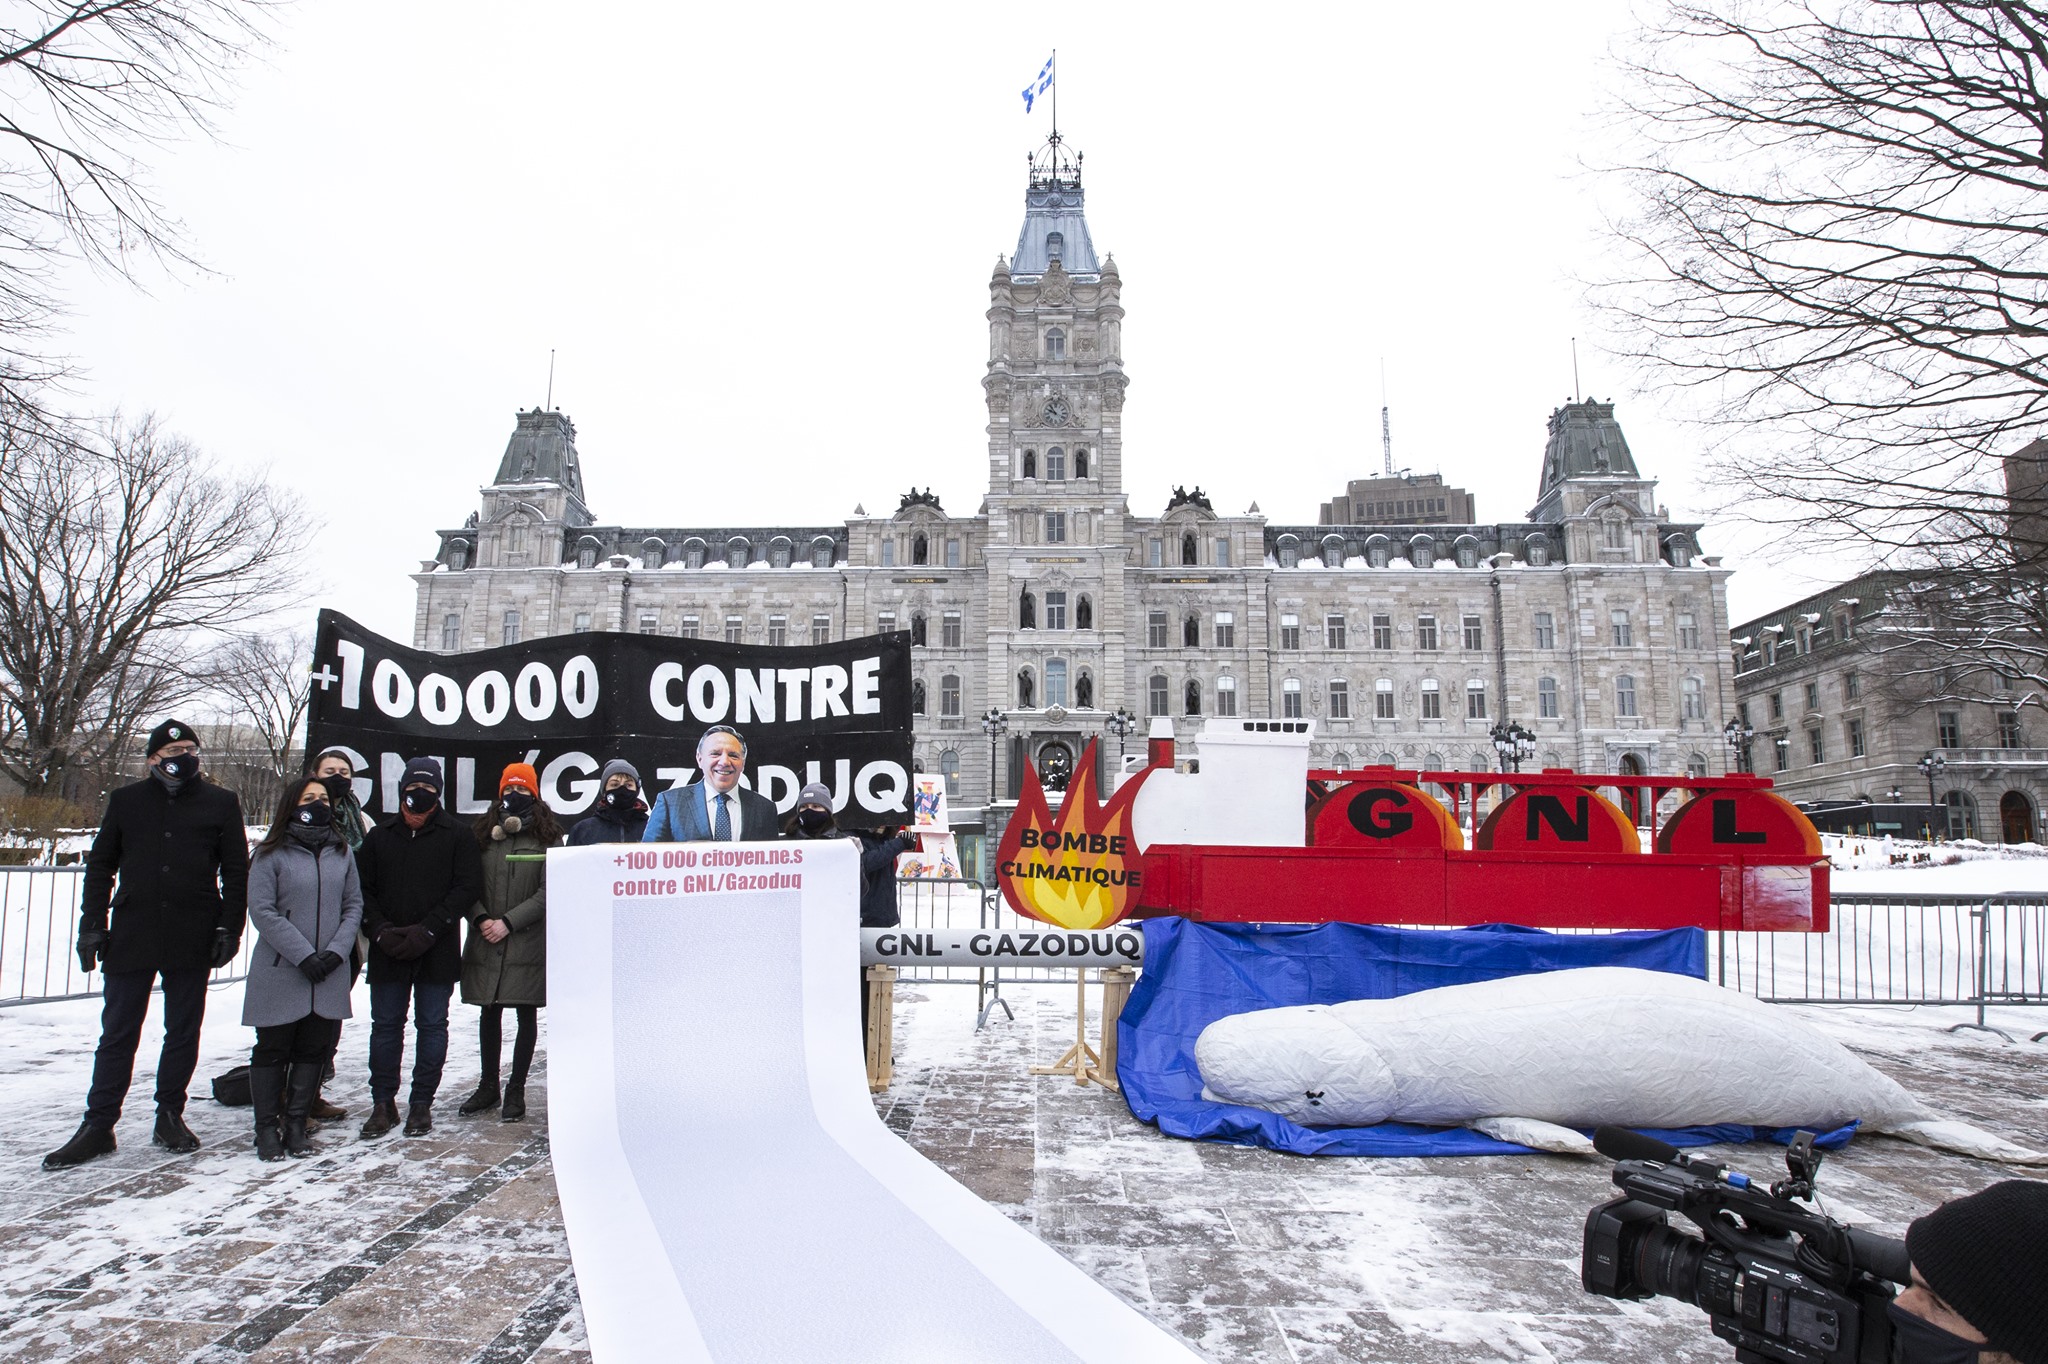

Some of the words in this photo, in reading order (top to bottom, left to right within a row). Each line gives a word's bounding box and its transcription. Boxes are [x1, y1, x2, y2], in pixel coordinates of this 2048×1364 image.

[650, 656, 882, 724] CONTRE
[1020, 828, 1128, 856] BOMBE
[613, 851, 658, 870] +100
[662, 850, 697, 869] 000
[701, 848, 803, 868] citoyen.ne.s
[612, 878, 677, 896] contre
[683, 872, 802, 893] GNL/Gazoduq
[1000, 861, 1142, 888] CLIMATIQUE
[875, 933, 943, 957] GNL
[969, 933, 1141, 961] GAZODUQ
